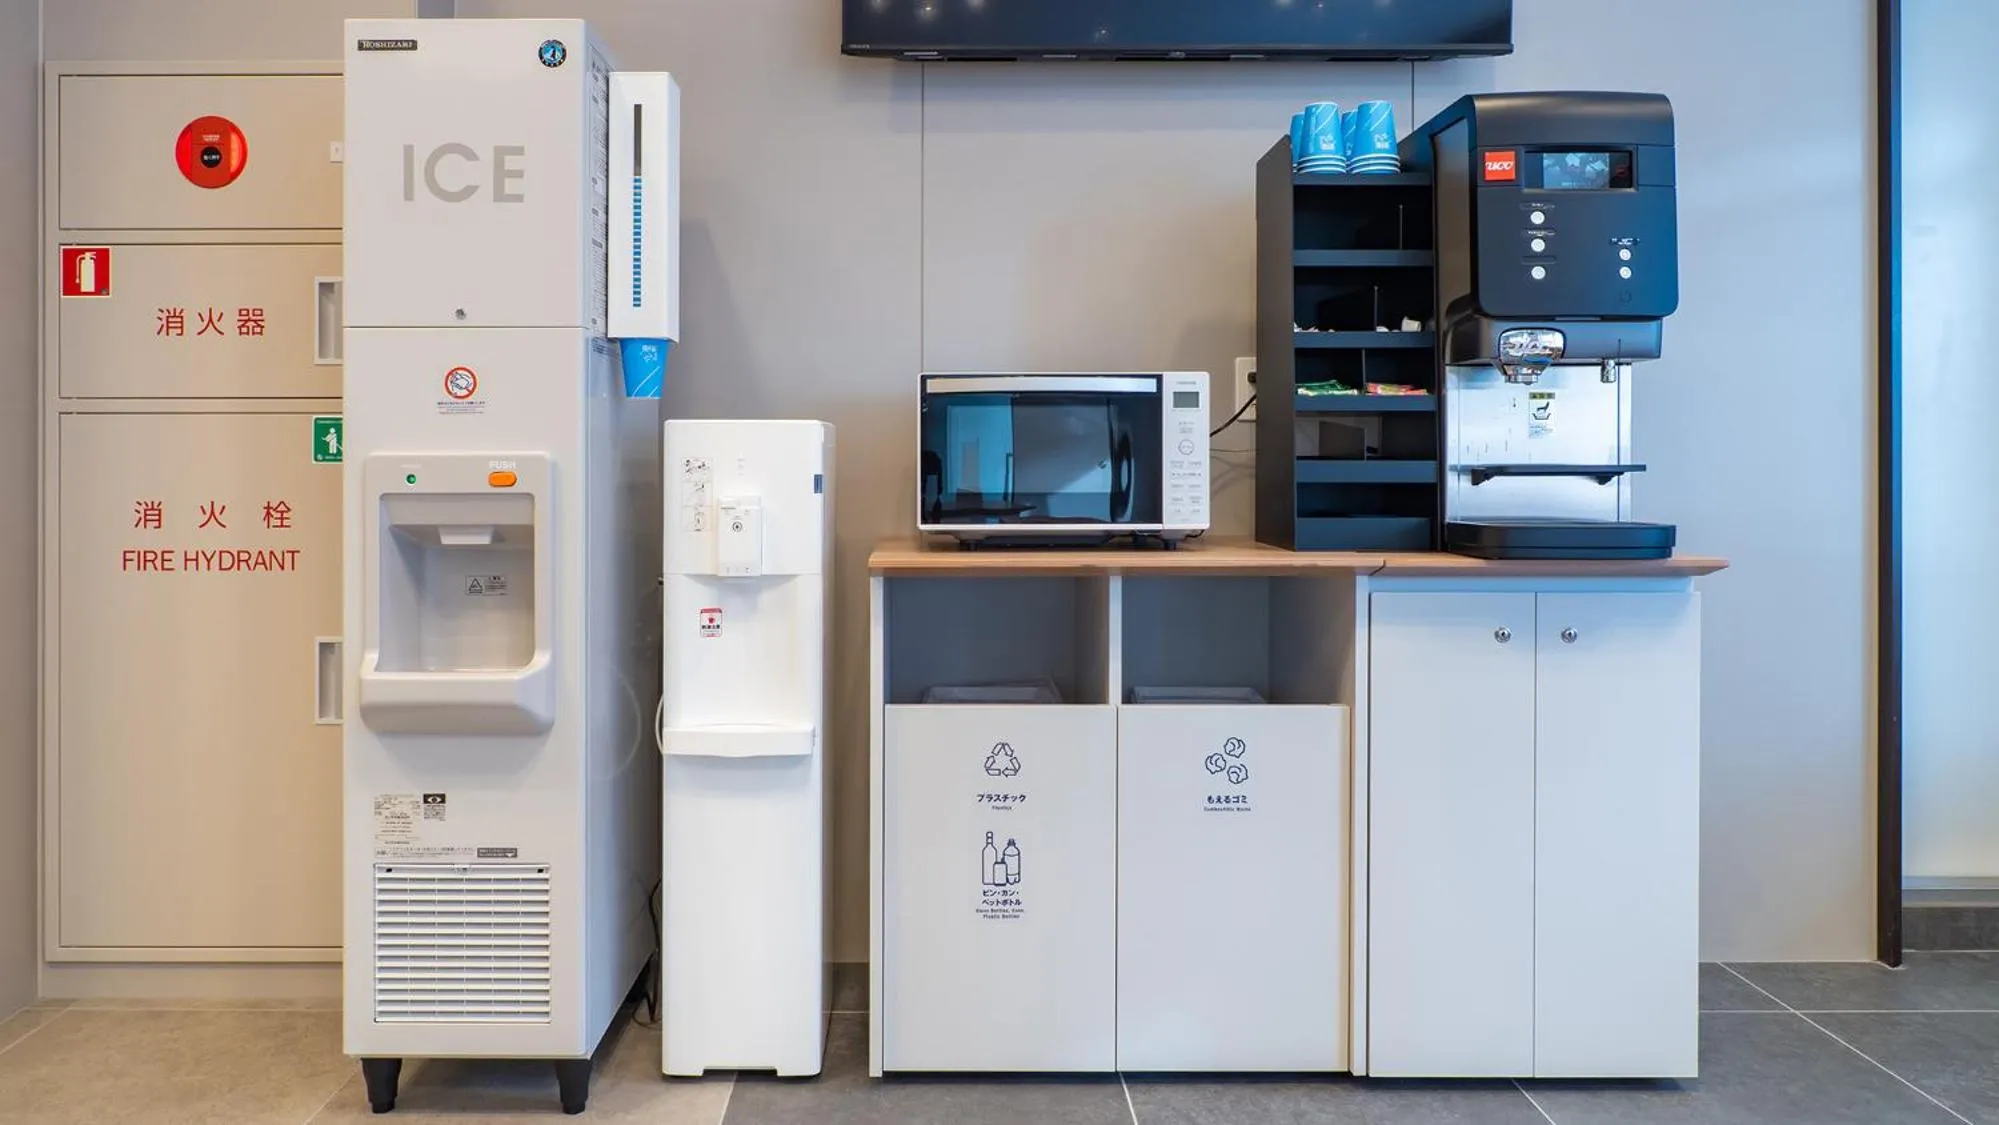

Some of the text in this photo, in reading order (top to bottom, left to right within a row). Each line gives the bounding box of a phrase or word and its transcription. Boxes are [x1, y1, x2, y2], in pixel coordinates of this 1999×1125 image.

[403, 143, 525, 203] ICE
[156, 307, 265, 337] 消火器
[134, 500, 292, 529] 消火栓
[122, 550, 301, 571] FIRE HYDRANT
[976, 793, 1027, 803] プラスチック
[1206, 794, 1248, 804] もえるゴミ
